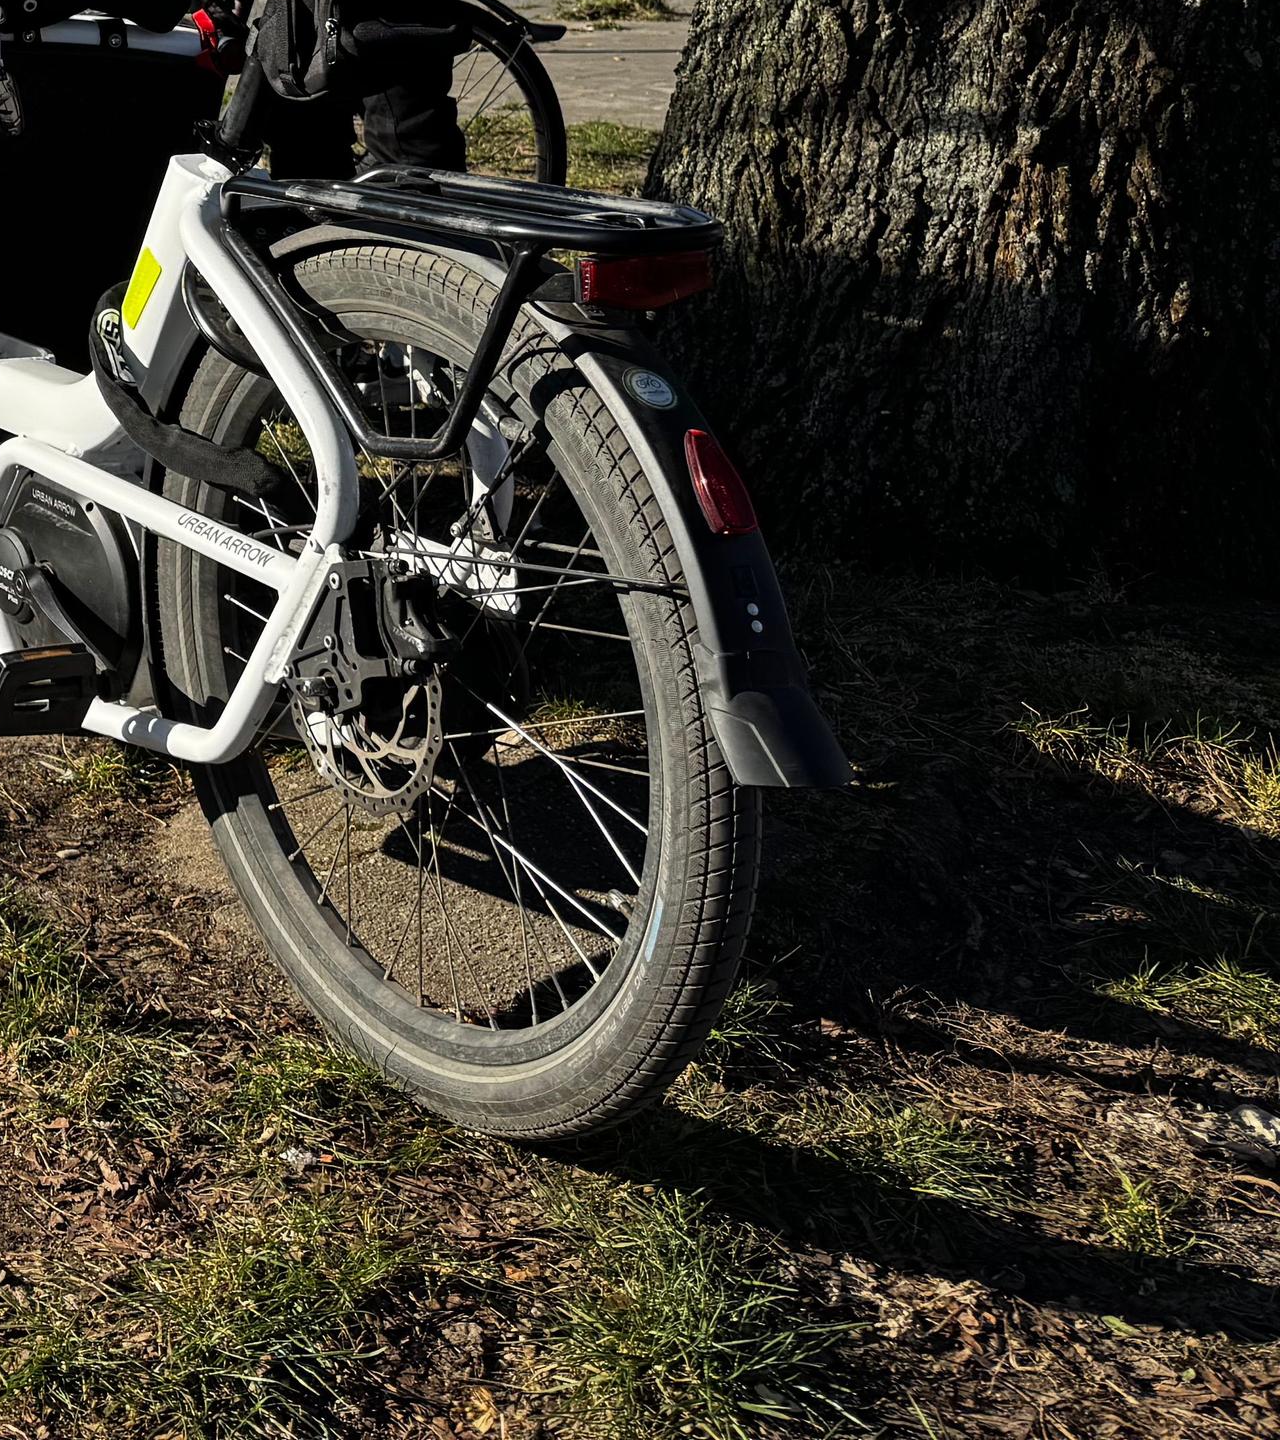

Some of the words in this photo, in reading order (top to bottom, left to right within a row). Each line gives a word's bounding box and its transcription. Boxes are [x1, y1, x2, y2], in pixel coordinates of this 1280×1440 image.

[32, 487, 53, 506] URBAN
[53, 498, 77, 518] ARROW
[177, 513, 223, 544] URBAN
[219, 535, 275, 568] ARROW
